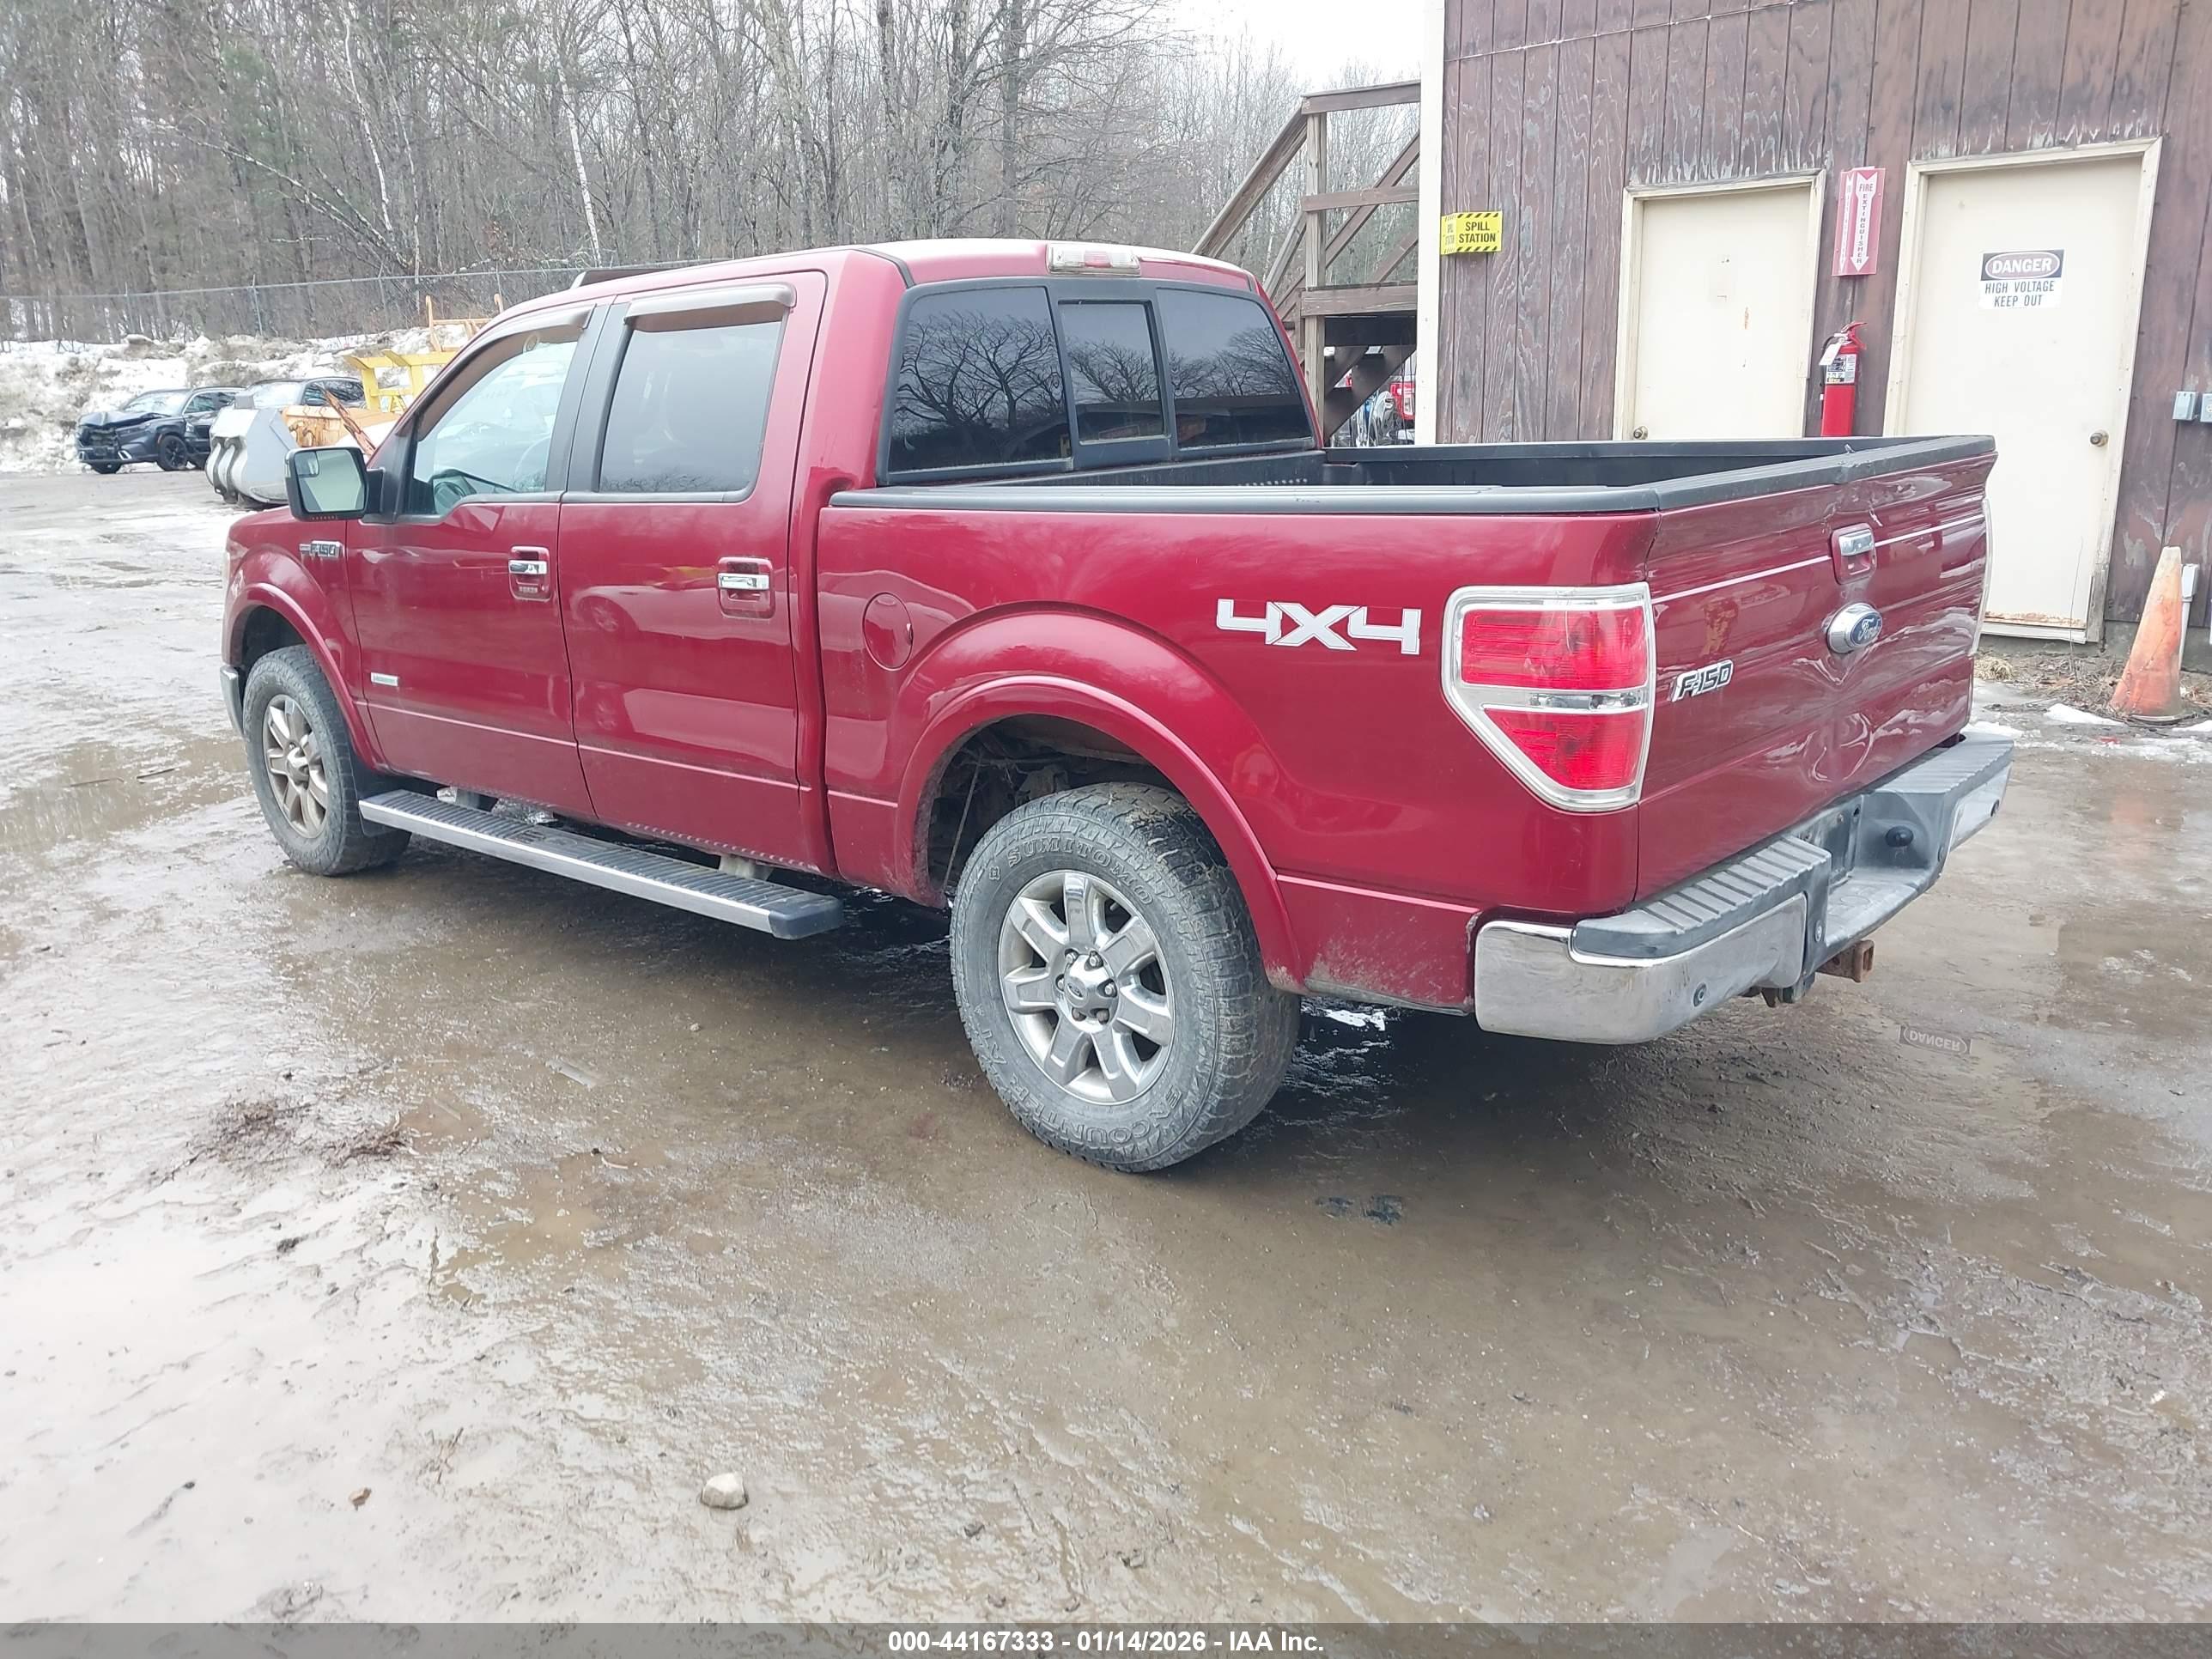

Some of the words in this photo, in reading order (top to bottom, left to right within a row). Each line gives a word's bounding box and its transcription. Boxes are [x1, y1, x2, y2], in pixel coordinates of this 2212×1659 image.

[1858, 183, 1874, 192] FIRE
[1465, 221, 1490, 232] SPILL
[1856, 193, 1868, 264] EXTINGUISHER
[1458, 233, 1496, 243] STATION
[1991, 258, 2052, 274] DANGER
[1984, 282, 2008, 295] HIGH
[2014, 280, 2054, 293] VOLTAGE
[1994, 295, 2019, 307] KEEP
[2024, 295, 2043, 307] OUT
[1854, 614, 1882, 642] Ford
[1007, 836, 1154, 904] SUMITOMO
